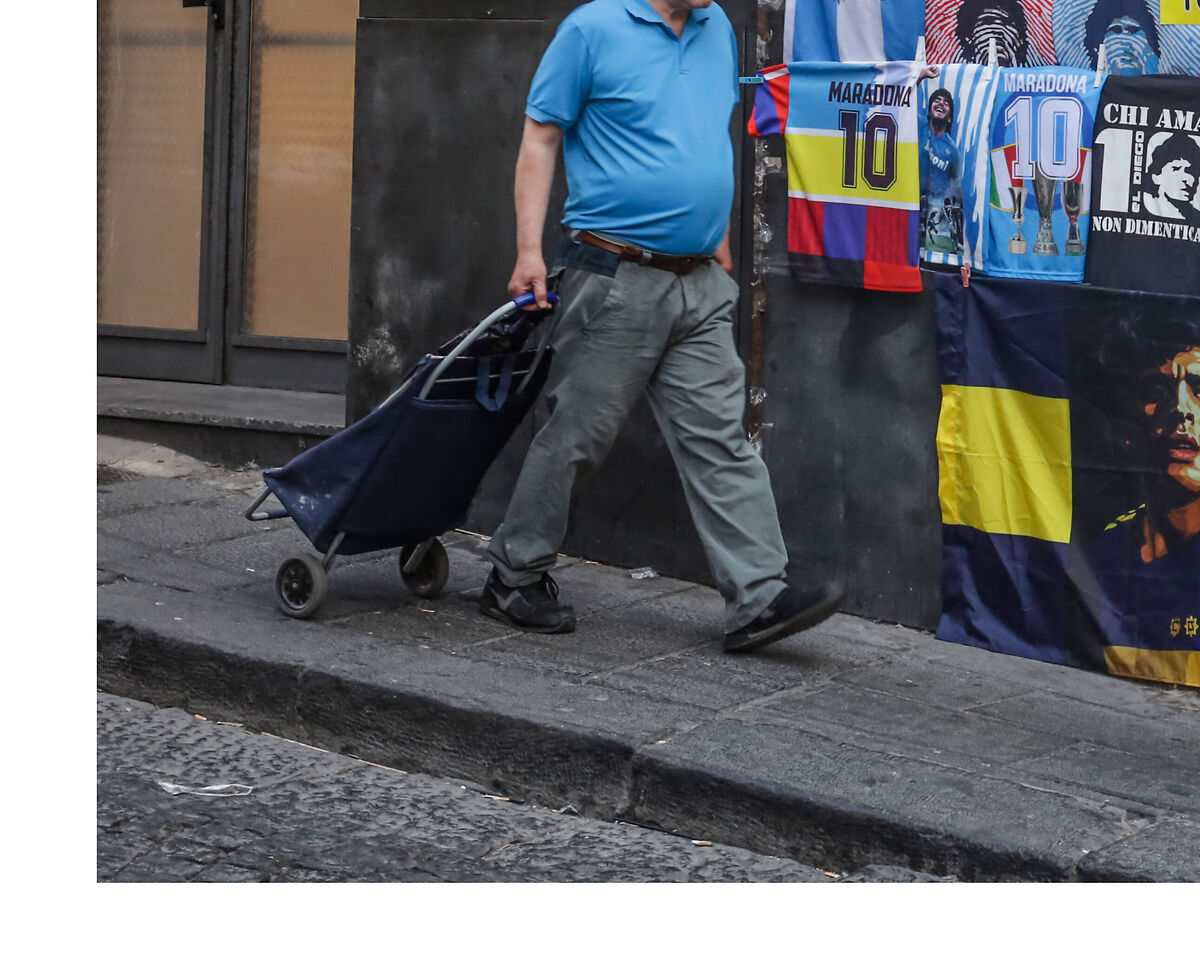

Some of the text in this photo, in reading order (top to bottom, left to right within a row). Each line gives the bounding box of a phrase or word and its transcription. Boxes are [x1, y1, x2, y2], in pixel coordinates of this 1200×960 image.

[828, 79, 912, 108] MARADONA
[1003, 73, 1087, 94] MARADONA
[1102, 102, 1150, 127] CHI
[838, 109, 899, 192] 10
[1004, 95, 1084, 181] 10
[1092, 216, 1125, 234] NON
